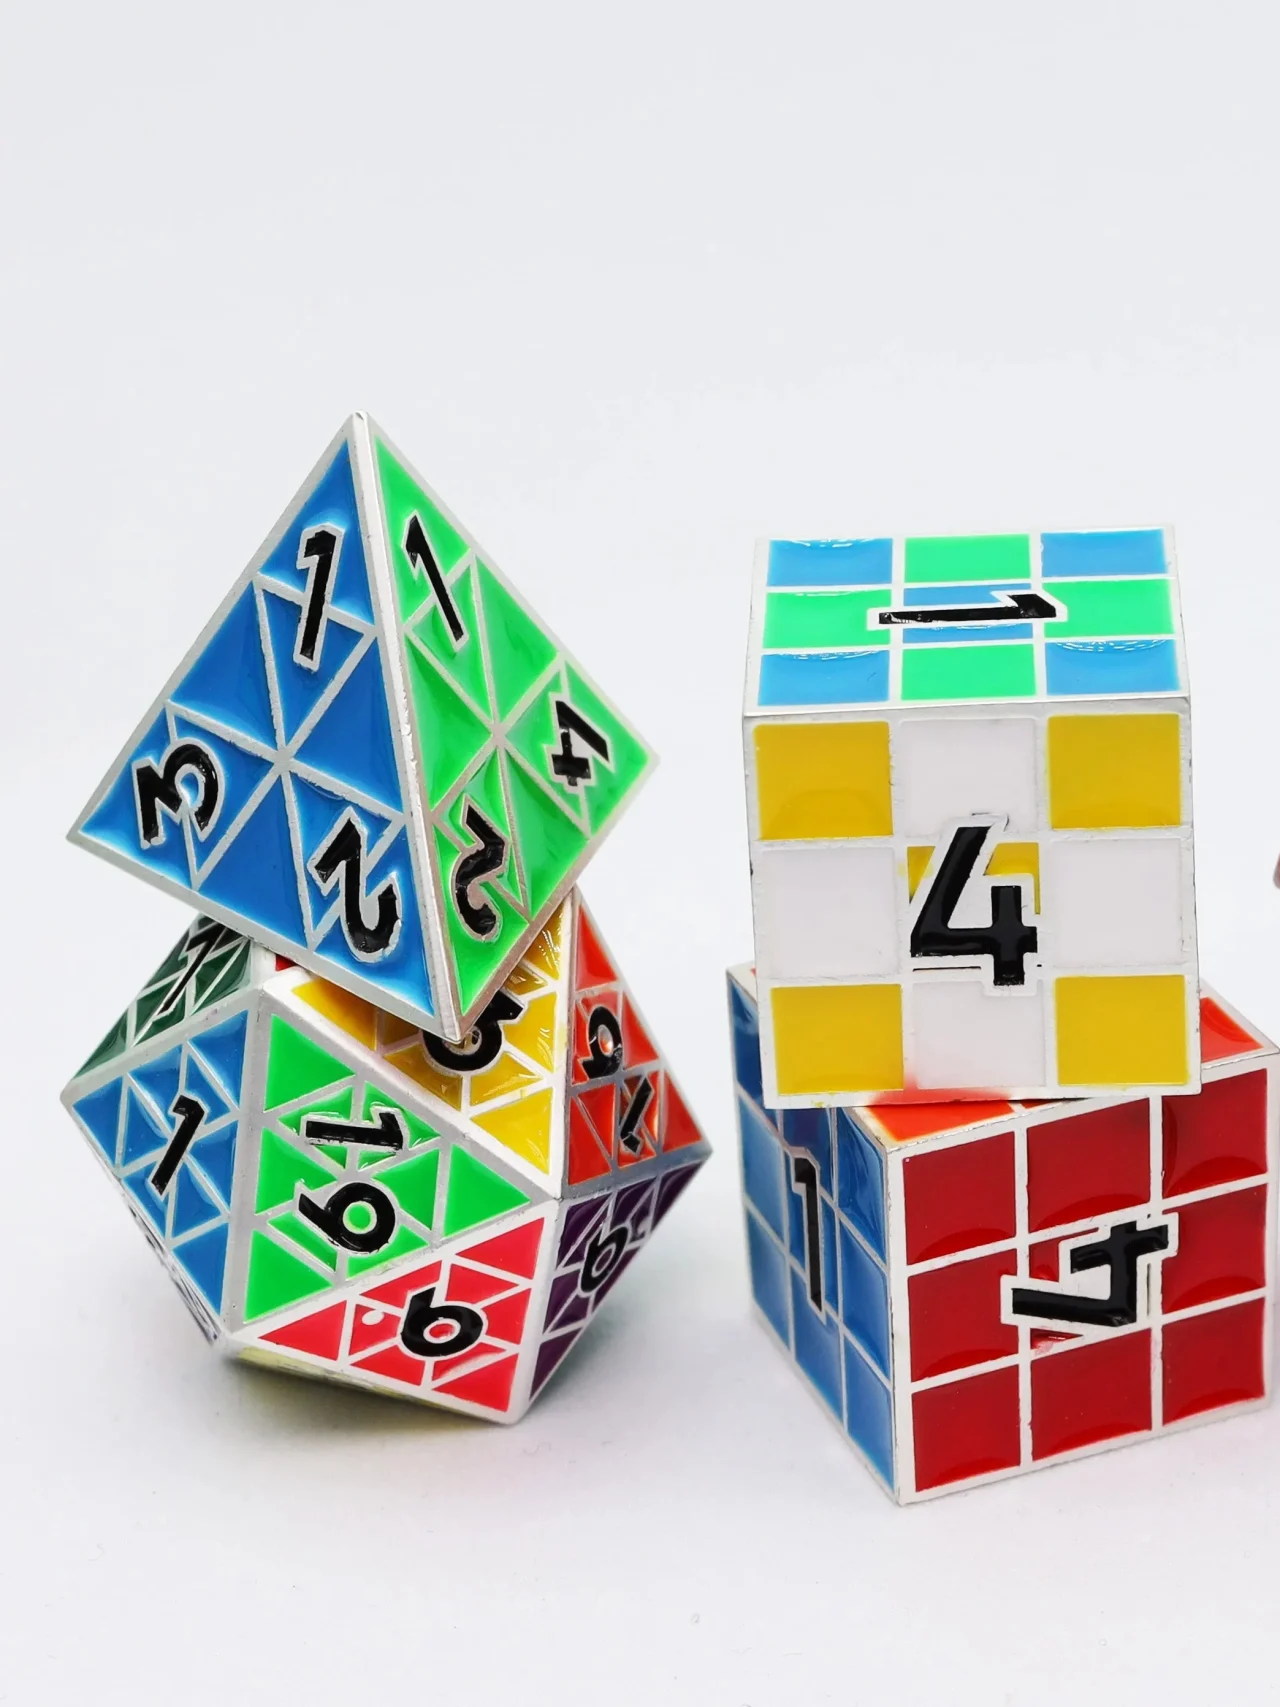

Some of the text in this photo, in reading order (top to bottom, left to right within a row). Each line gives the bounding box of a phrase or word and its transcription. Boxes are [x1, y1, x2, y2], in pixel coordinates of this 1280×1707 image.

[299, 530, 337, 661] 1
[405, 515, 464, 641] 1
[878, 593, 1057, 625] 1
[136, 743, 219, 843] 3
[551, 700, 609, 787] 4
[314, 817, 400, 954] 2
[455, 804, 505, 936] 2
[909, 826, 1038, 987] 4
[151, 1095, 205, 1195] 1
[794, 1157, 822, 1311] 1
[1011, 1220, 1169, 1328] 4
